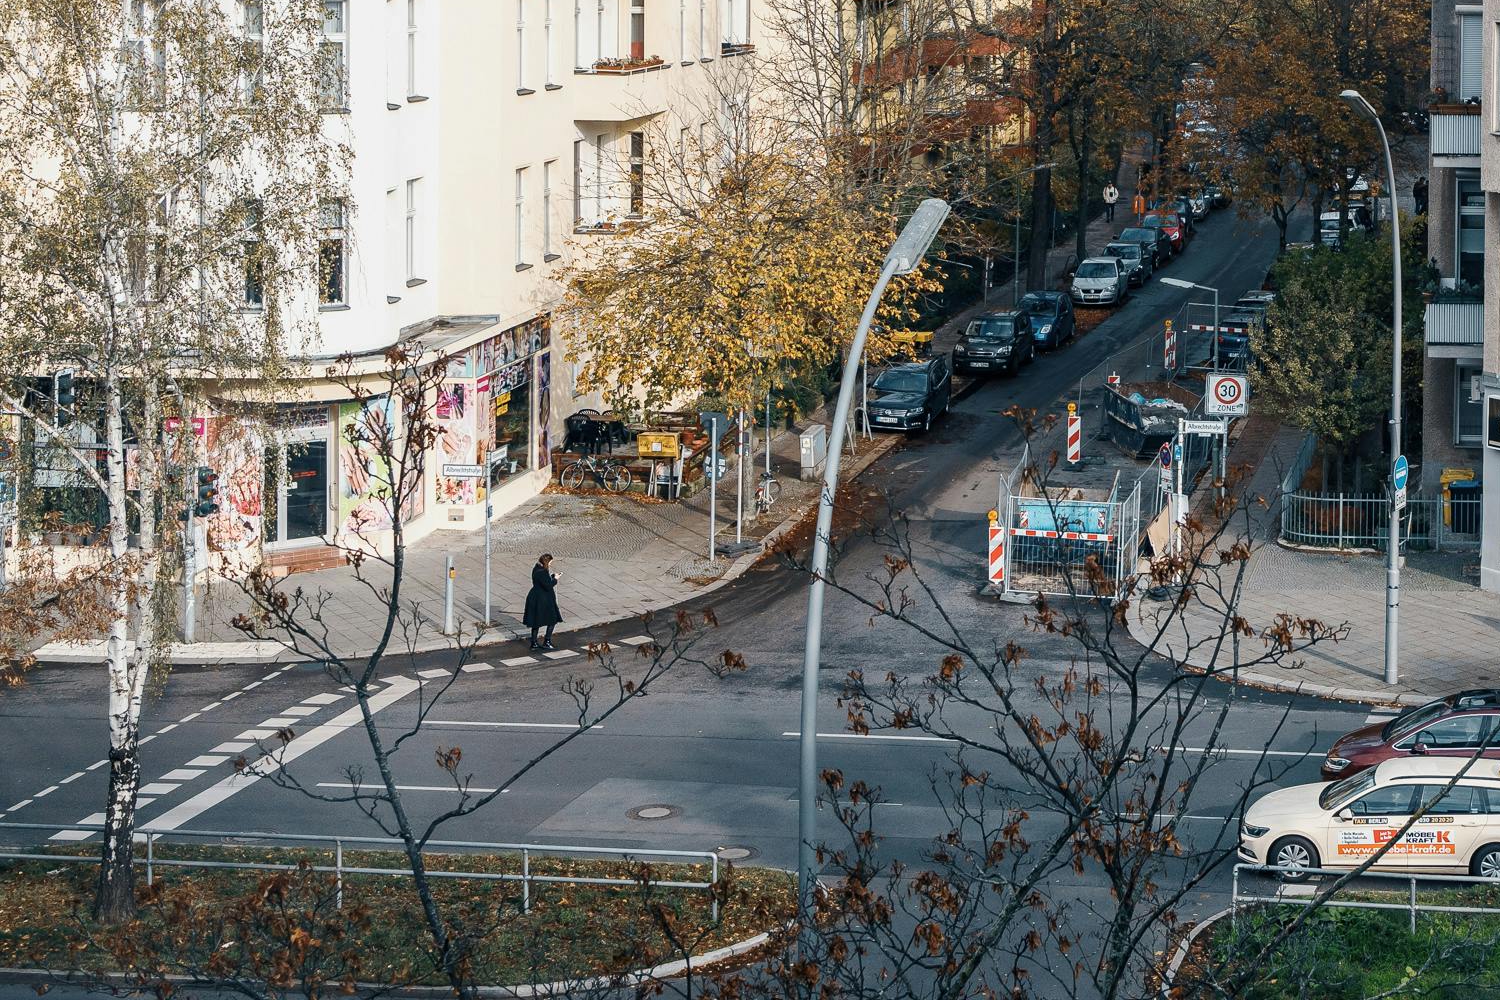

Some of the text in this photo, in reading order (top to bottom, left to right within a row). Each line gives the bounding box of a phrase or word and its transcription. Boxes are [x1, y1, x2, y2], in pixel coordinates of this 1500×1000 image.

[1220, 384, 1236, 398] 30
[1217, 404, 1236, 412] ZONE
[1187, 423, 1222, 431] Albrechtstraße
[1342, 845, 1452, 854] www.mebel-kraft.de
